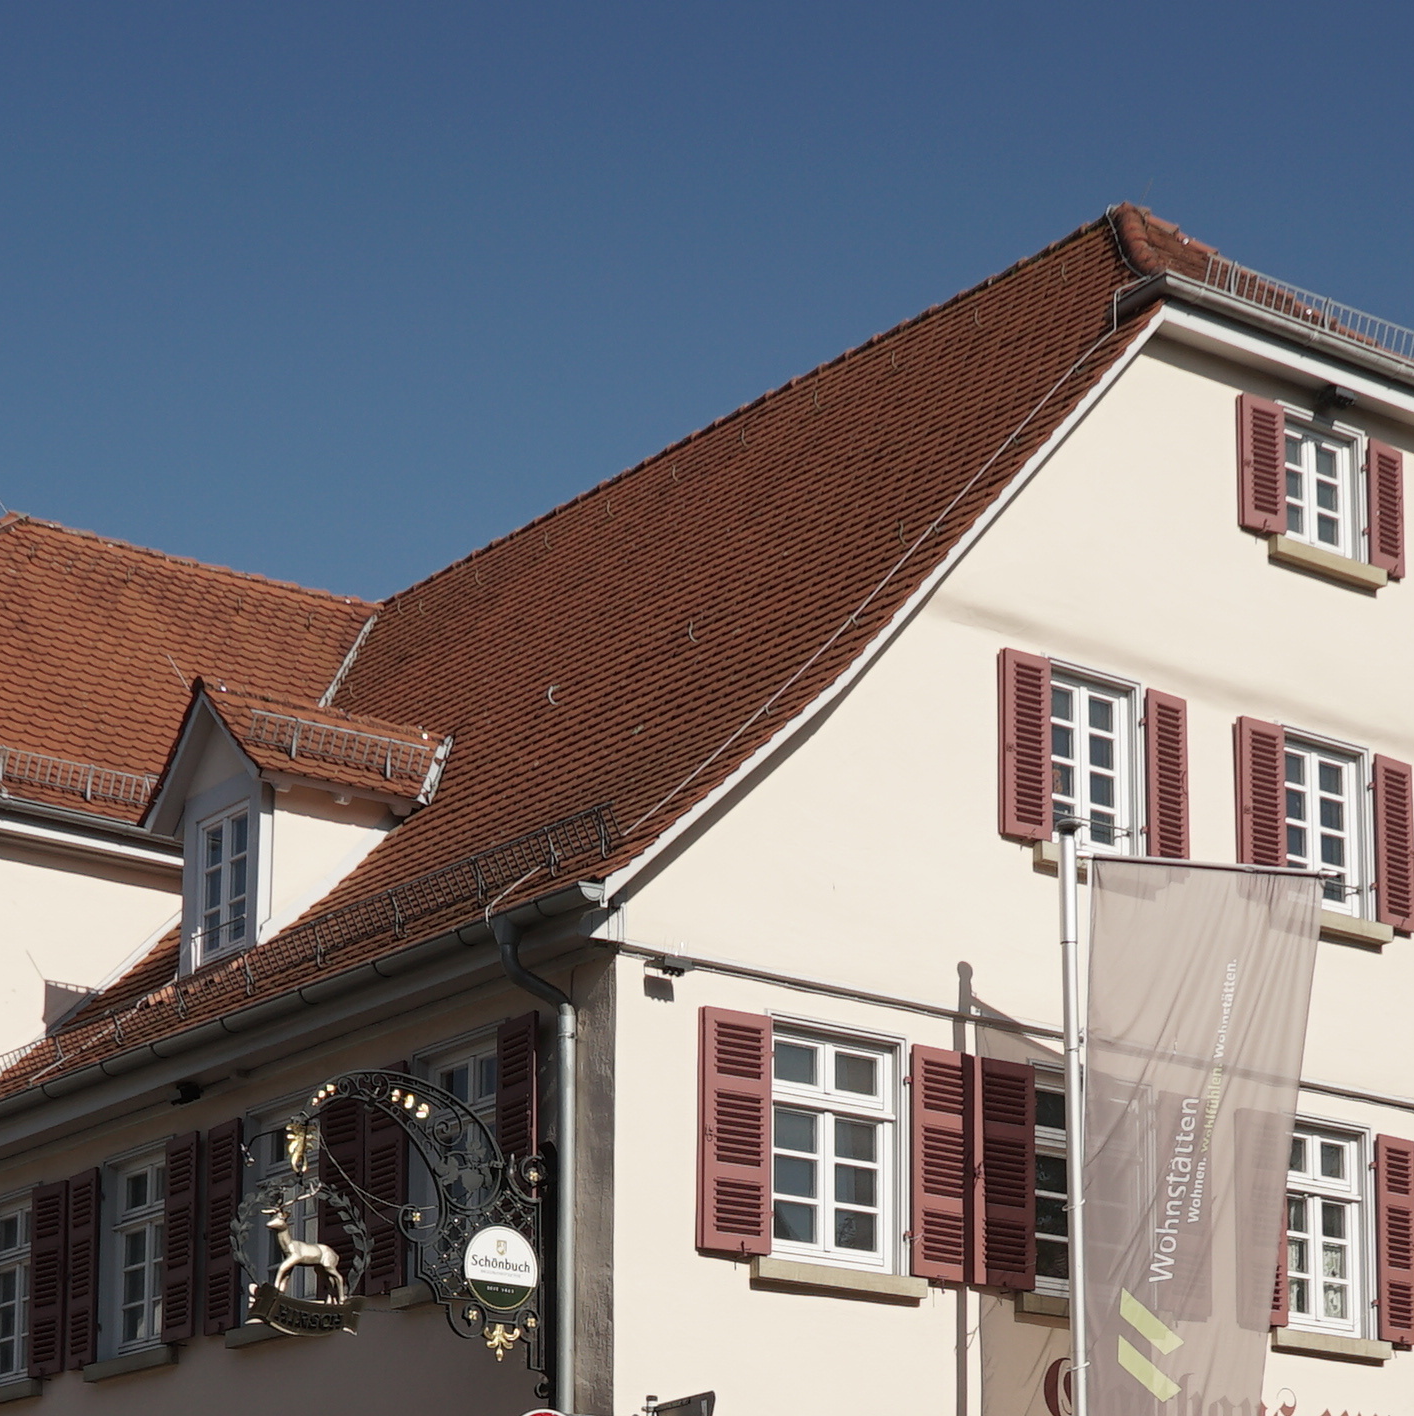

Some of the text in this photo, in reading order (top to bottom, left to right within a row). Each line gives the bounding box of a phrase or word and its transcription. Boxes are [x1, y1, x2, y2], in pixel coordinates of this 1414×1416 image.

[1148, 1097, 1200, 1283] Wohnstätten
[1187, 1157, 1207, 1224] Wohnen.
[471, 1254, 531, 1273] Schönbuch
